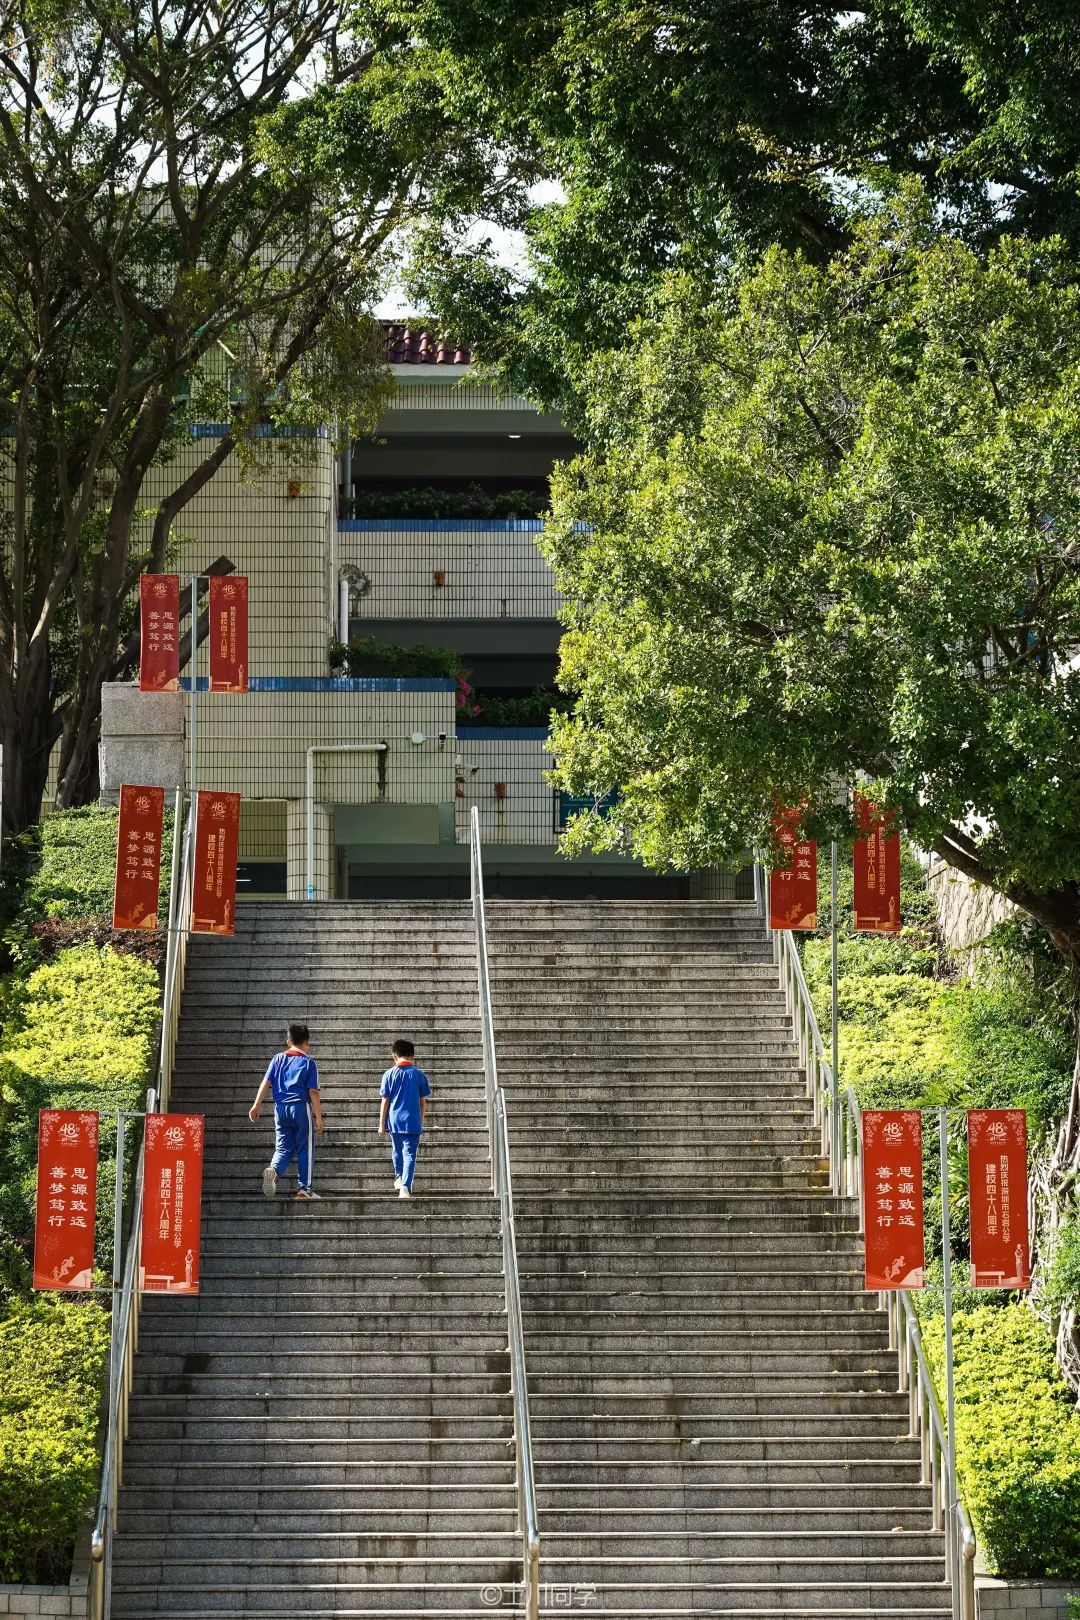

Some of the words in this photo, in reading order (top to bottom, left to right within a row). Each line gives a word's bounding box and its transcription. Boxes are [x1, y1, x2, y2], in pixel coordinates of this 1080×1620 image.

[125, 830, 141, 879] 善梦笃行
[142, 831, 156, 880] 思源致远
[59, 1123, 75, 1135] 48
[165, 1127, 181, 1139] 48
[883, 1122, 899, 1135] 48
[987, 1121, 1003, 1134] 48
[48, 1167, 67, 1227] 善梦笃行
[69, 1167, 89, 1228] 思源致远
[159, 1168, 172, 1240] 建校四十八周年
[173, 1160, 185, 1248] 热烈庆祝深圳市石岩公学
[876, 1166, 894, 1227] 善梦笃行
[897, 1166, 916, 1227] 思源致远
[985, 1163, 998, 1236] 建校四十八周年
[1000, 1155, 1011, 1243] 热烈庆祝深圳市石岩公学
